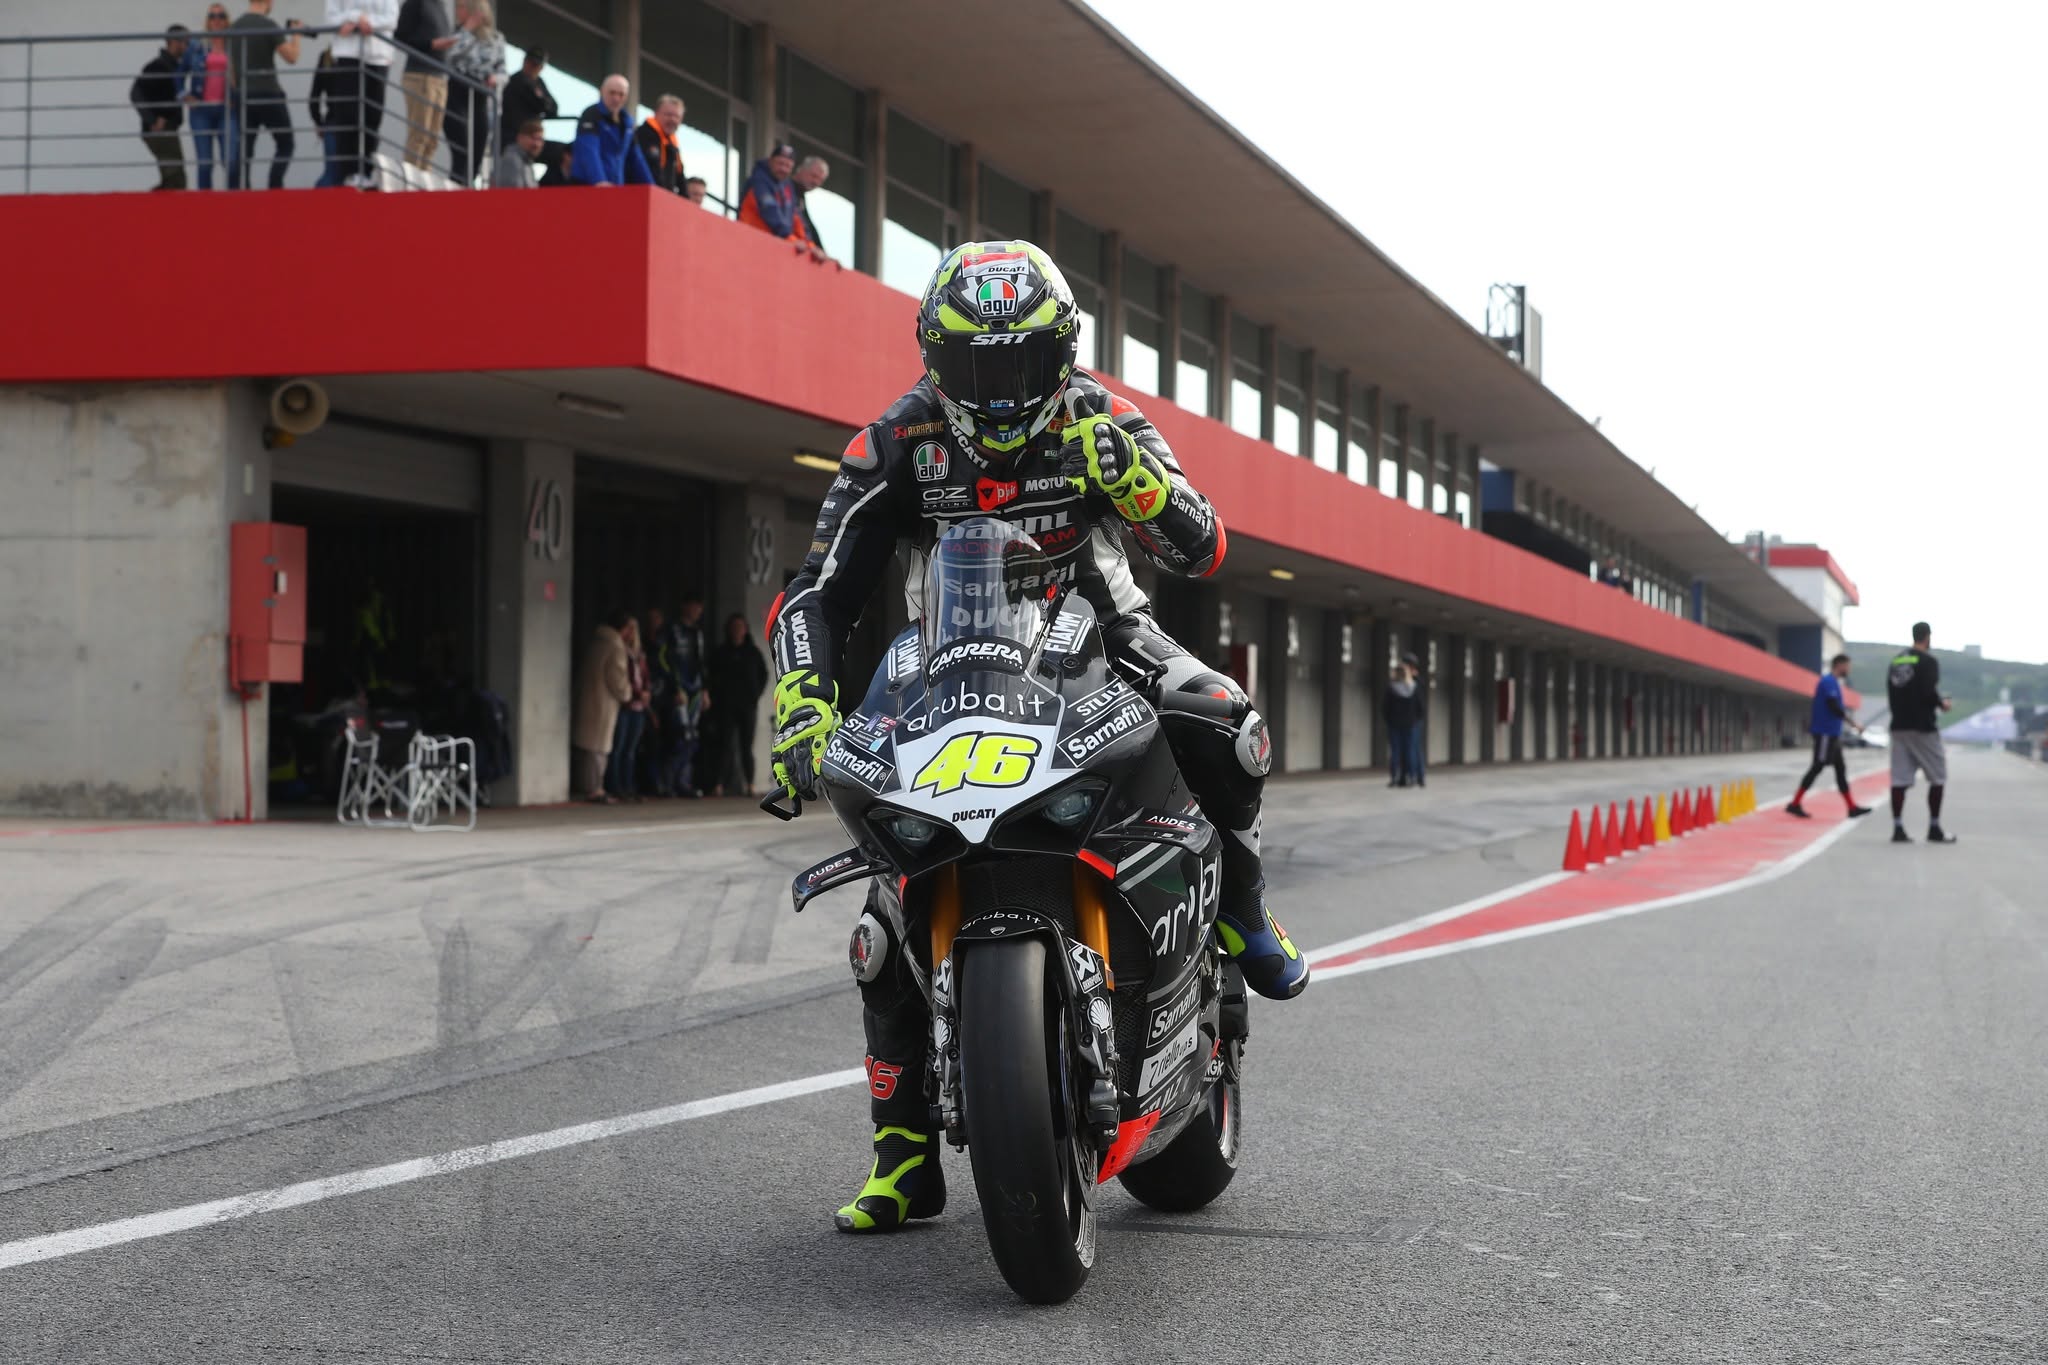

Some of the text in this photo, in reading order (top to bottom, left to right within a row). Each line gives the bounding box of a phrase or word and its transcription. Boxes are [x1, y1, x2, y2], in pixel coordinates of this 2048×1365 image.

[982, 299, 1014, 315] agv
[970, 331, 1032, 346] SRT
[948, 419, 990, 470] UCATI
[999, 427, 1023, 442] TIM
[920, 464, 945, 479] agv
[1025, 475, 1068, 493] MOTU
[922, 486, 968, 501] OZ
[528, 478, 562, 561] 40
[749, 515, 775, 586] 39
[790, 609, 813, 666] DUCATI
[1044, 610, 1083, 653] FIAMM
[897, 633, 921, 678] FIAMM
[929, 642, 1023, 676] CARRERA
[907, 681, 1045, 732] aruba.it
[1076, 682, 1128, 717] STULZ
[911, 731, 1041, 799] 46
[951, 808, 996, 823] DUCATI
[1148, 815, 1198, 831] AUDES
[807, 856, 853, 882] AUDES
[961, 911, 1042, 931] aruba.it
